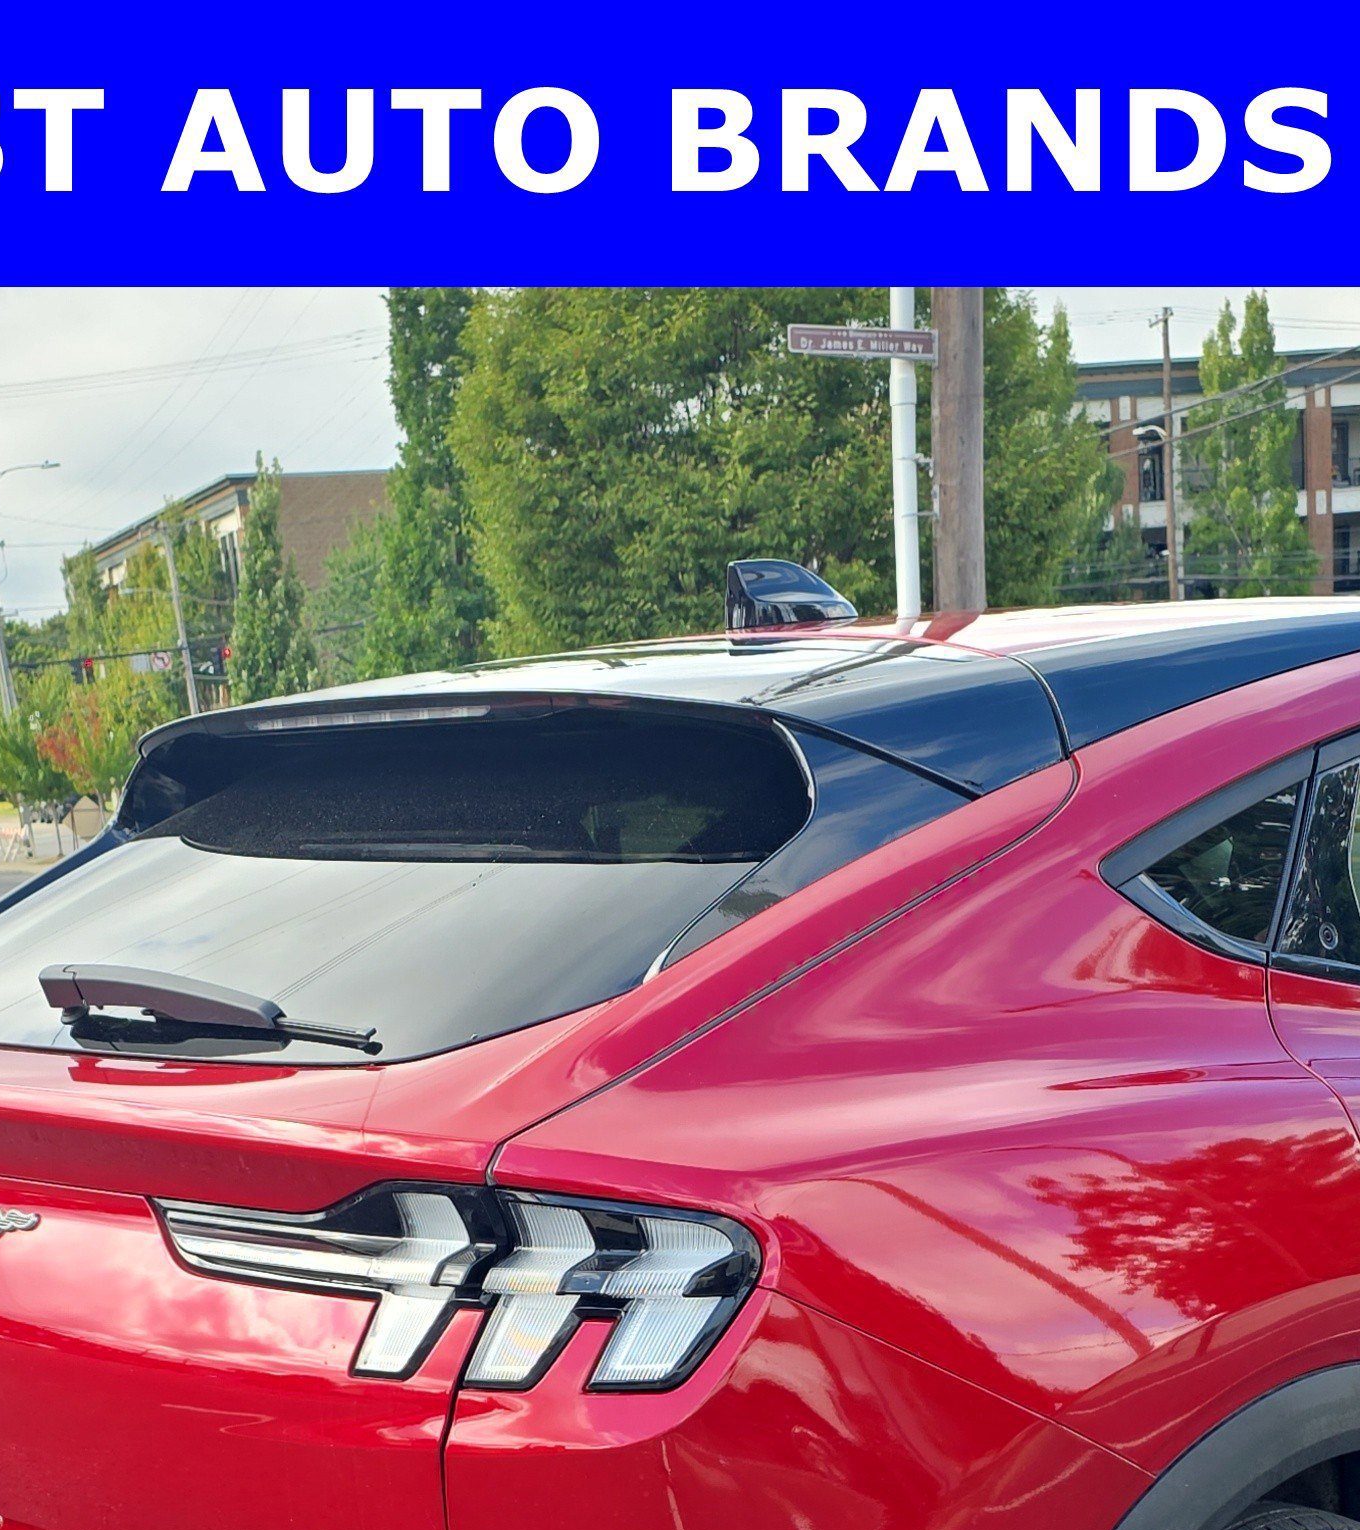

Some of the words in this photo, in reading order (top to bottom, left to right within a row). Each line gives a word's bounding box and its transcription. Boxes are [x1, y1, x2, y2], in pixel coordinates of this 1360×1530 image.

[820, 337, 854, 350] James
[870, 340, 900, 353] Miller
[903, 341, 924, 354] Way
